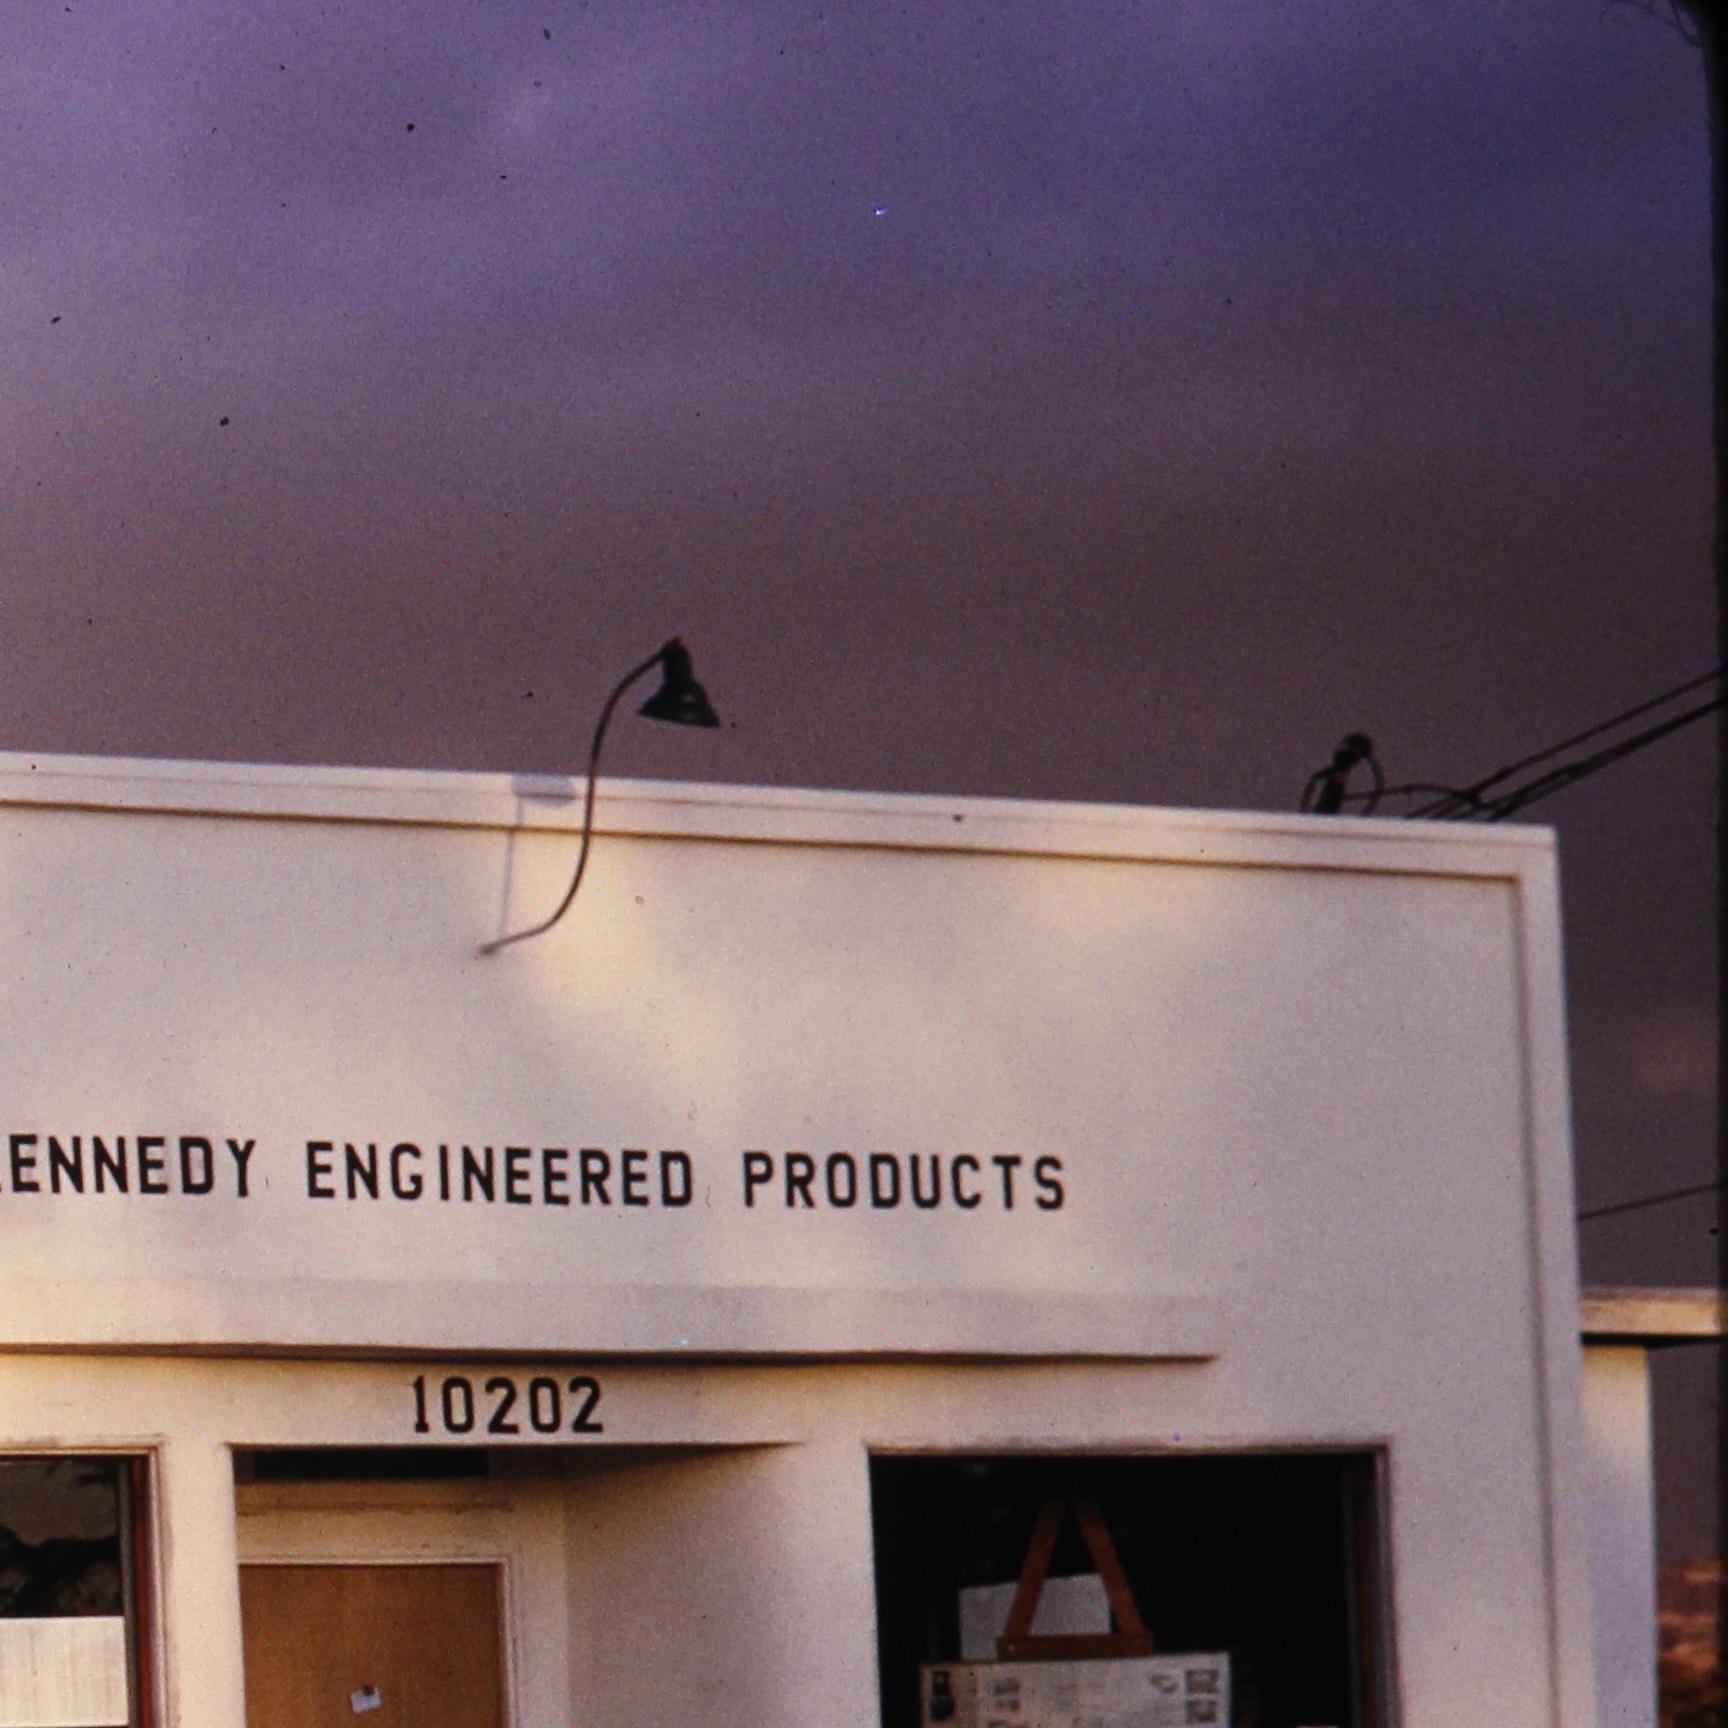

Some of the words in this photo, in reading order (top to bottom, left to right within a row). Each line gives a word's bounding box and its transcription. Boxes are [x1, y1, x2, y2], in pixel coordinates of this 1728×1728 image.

[306, 1141, 694, 1207] ENGINEERED
[743, 1151, 1065, 1211] PRODUCTS
[412, 1375, 605, 1435] 10202
